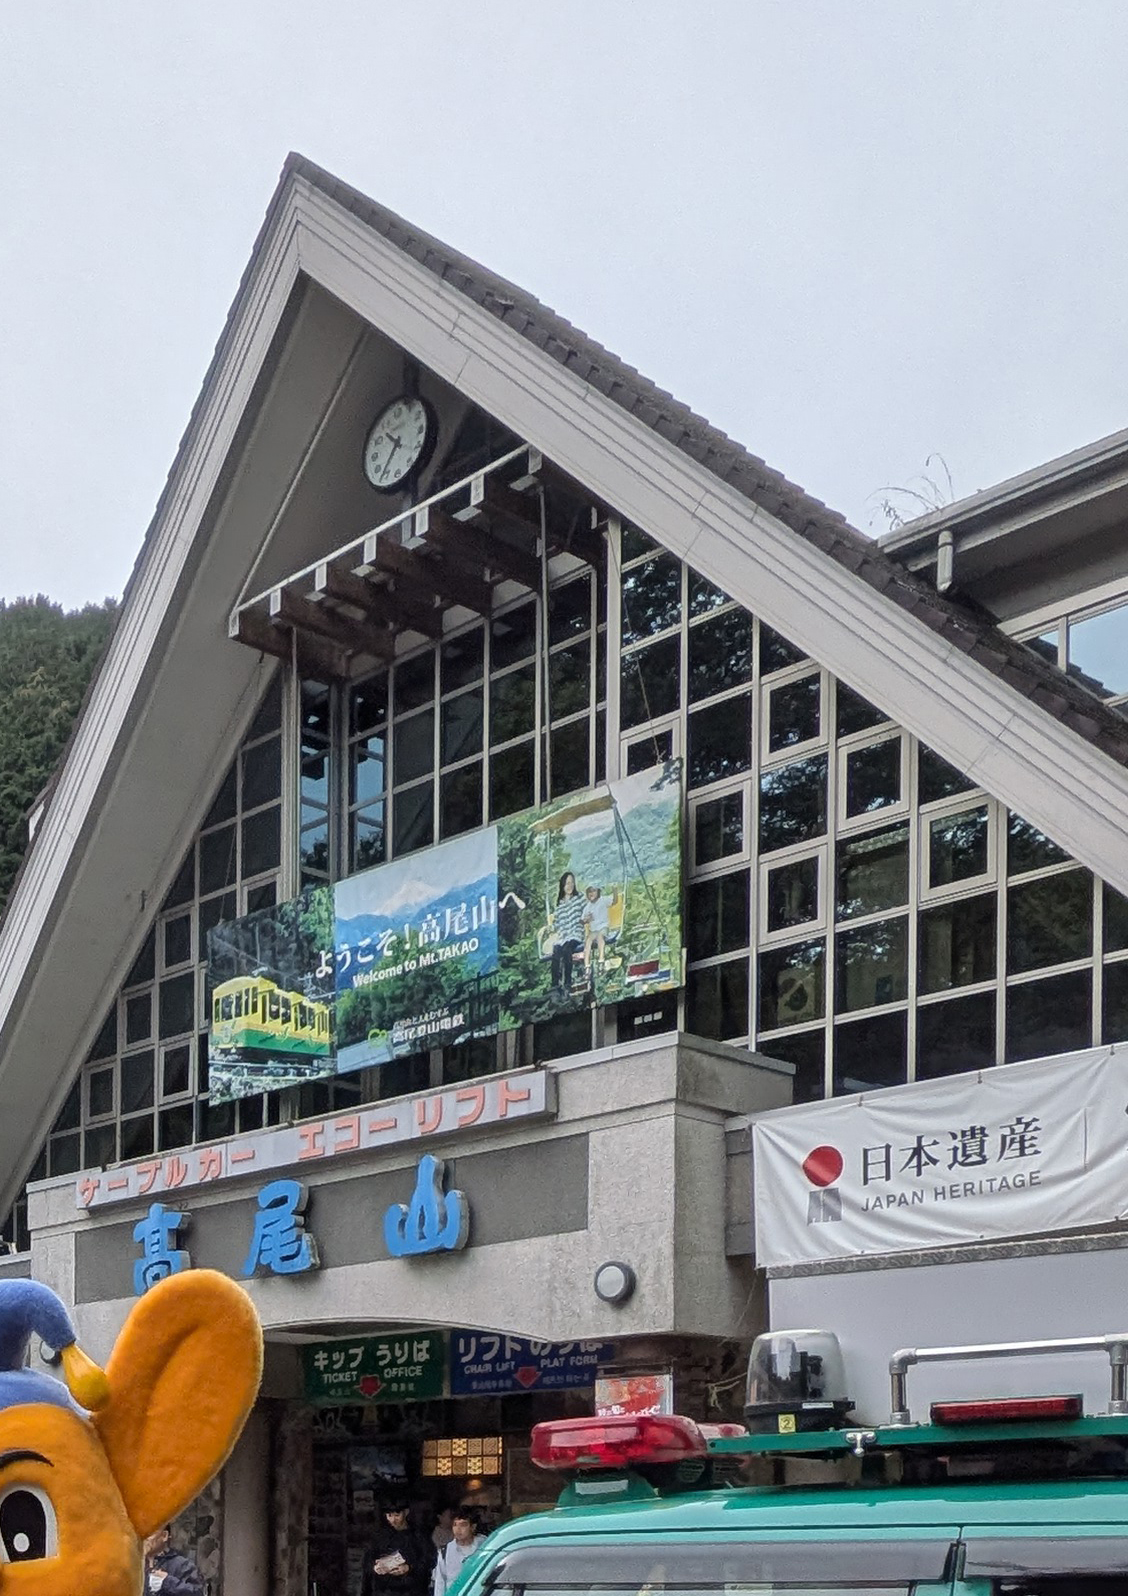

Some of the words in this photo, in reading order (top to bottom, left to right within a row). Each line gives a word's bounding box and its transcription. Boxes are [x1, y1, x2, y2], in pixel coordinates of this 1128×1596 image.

[352, 965, 403, 988] Welcome
[404, 960, 416, 975] to
[419, 937, 479, 969] Mt.TAKAO
[862, 1116, 1043, 1186] 日本遺産
[78, 1148, 256, 1207] ケーブルカー
[861, 1189, 924, 1212] JAPAN
[934, 1170, 1042, 1202] HERITAGE
[133, 1153, 469, 1295] 高尾山
[314, 1345, 365, 1371] キップ
[376, 1340, 430, 1366] うりば
[458, 1336, 522, 1363] リフト
[464, 1363, 492, 1374] CHAIR
[496, 1361, 515, 1372] LIFT
[540, 1357, 565, 1368] PLAT
[322, 1371, 358, 1384] TICKET
[383, 1365, 423, 1379] OFFICE
